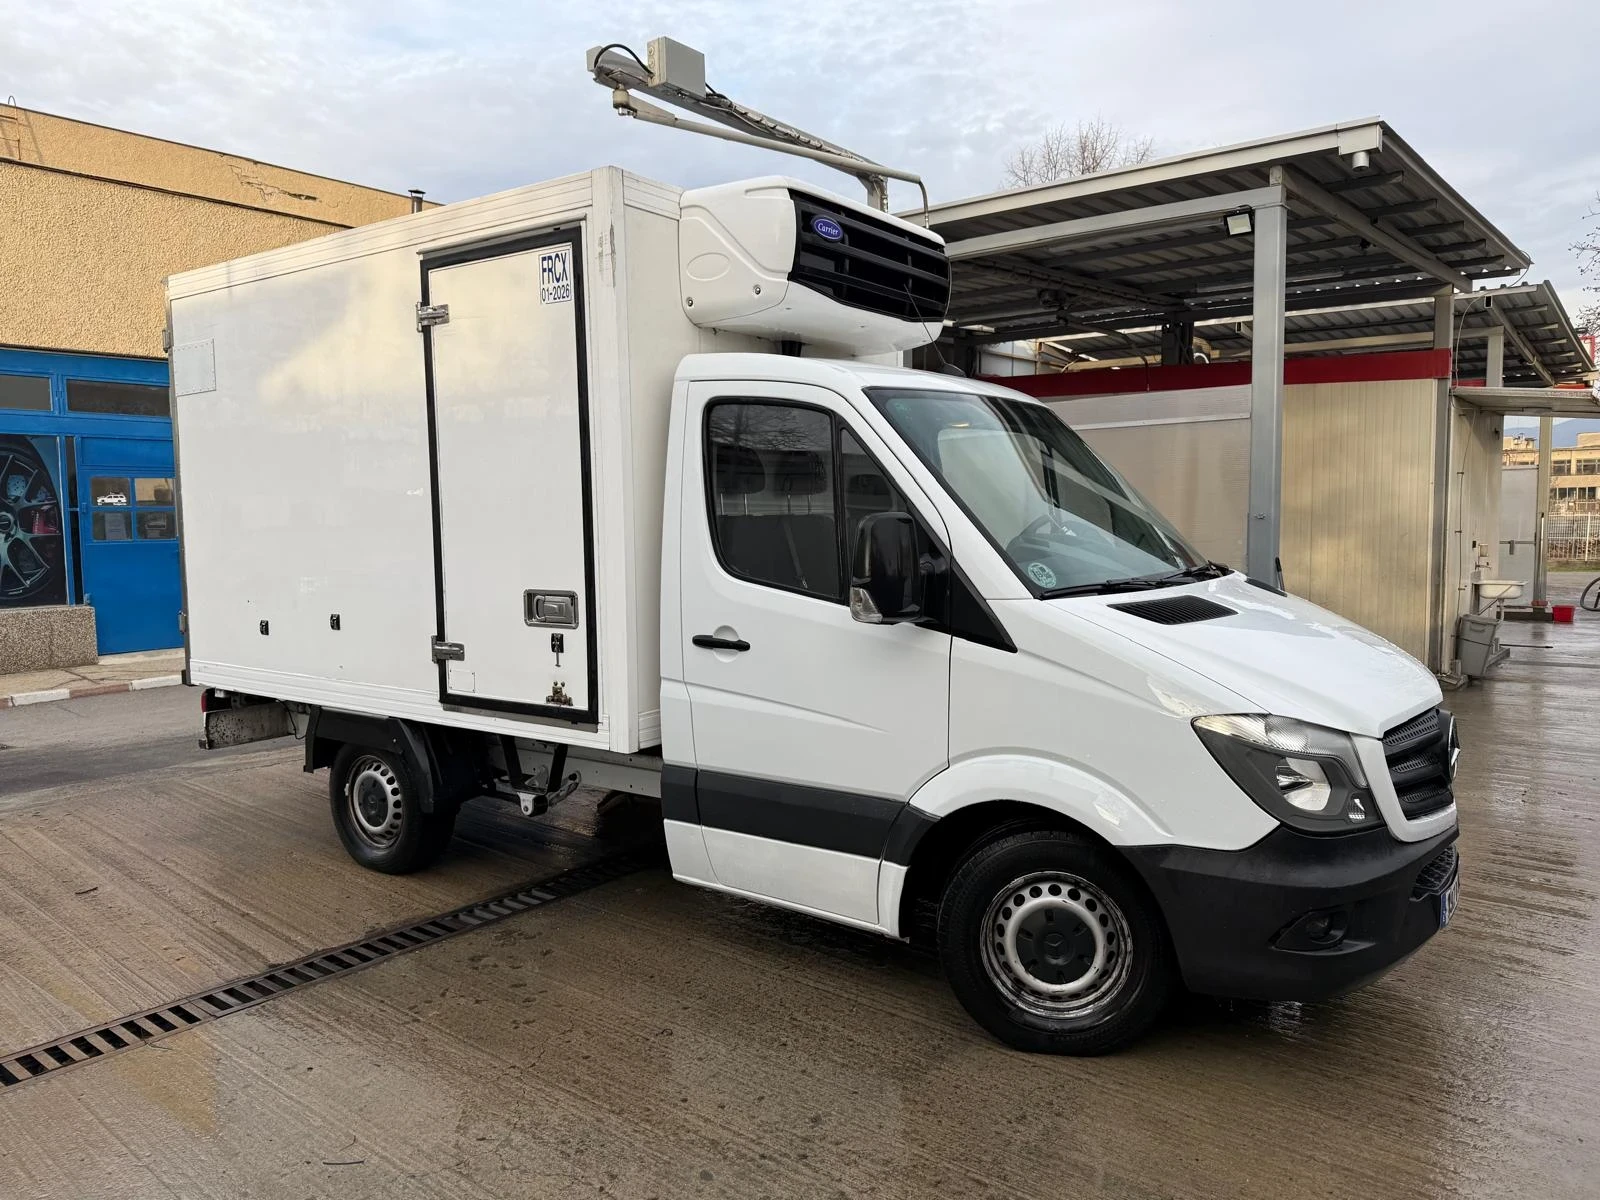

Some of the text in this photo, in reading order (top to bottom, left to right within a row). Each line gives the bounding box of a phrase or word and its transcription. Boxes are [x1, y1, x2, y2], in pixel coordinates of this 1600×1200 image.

[817, 223, 838, 235] Carrier
[541, 252, 568, 285] FRCX
[541, 283, 570, 302] 01-2026
